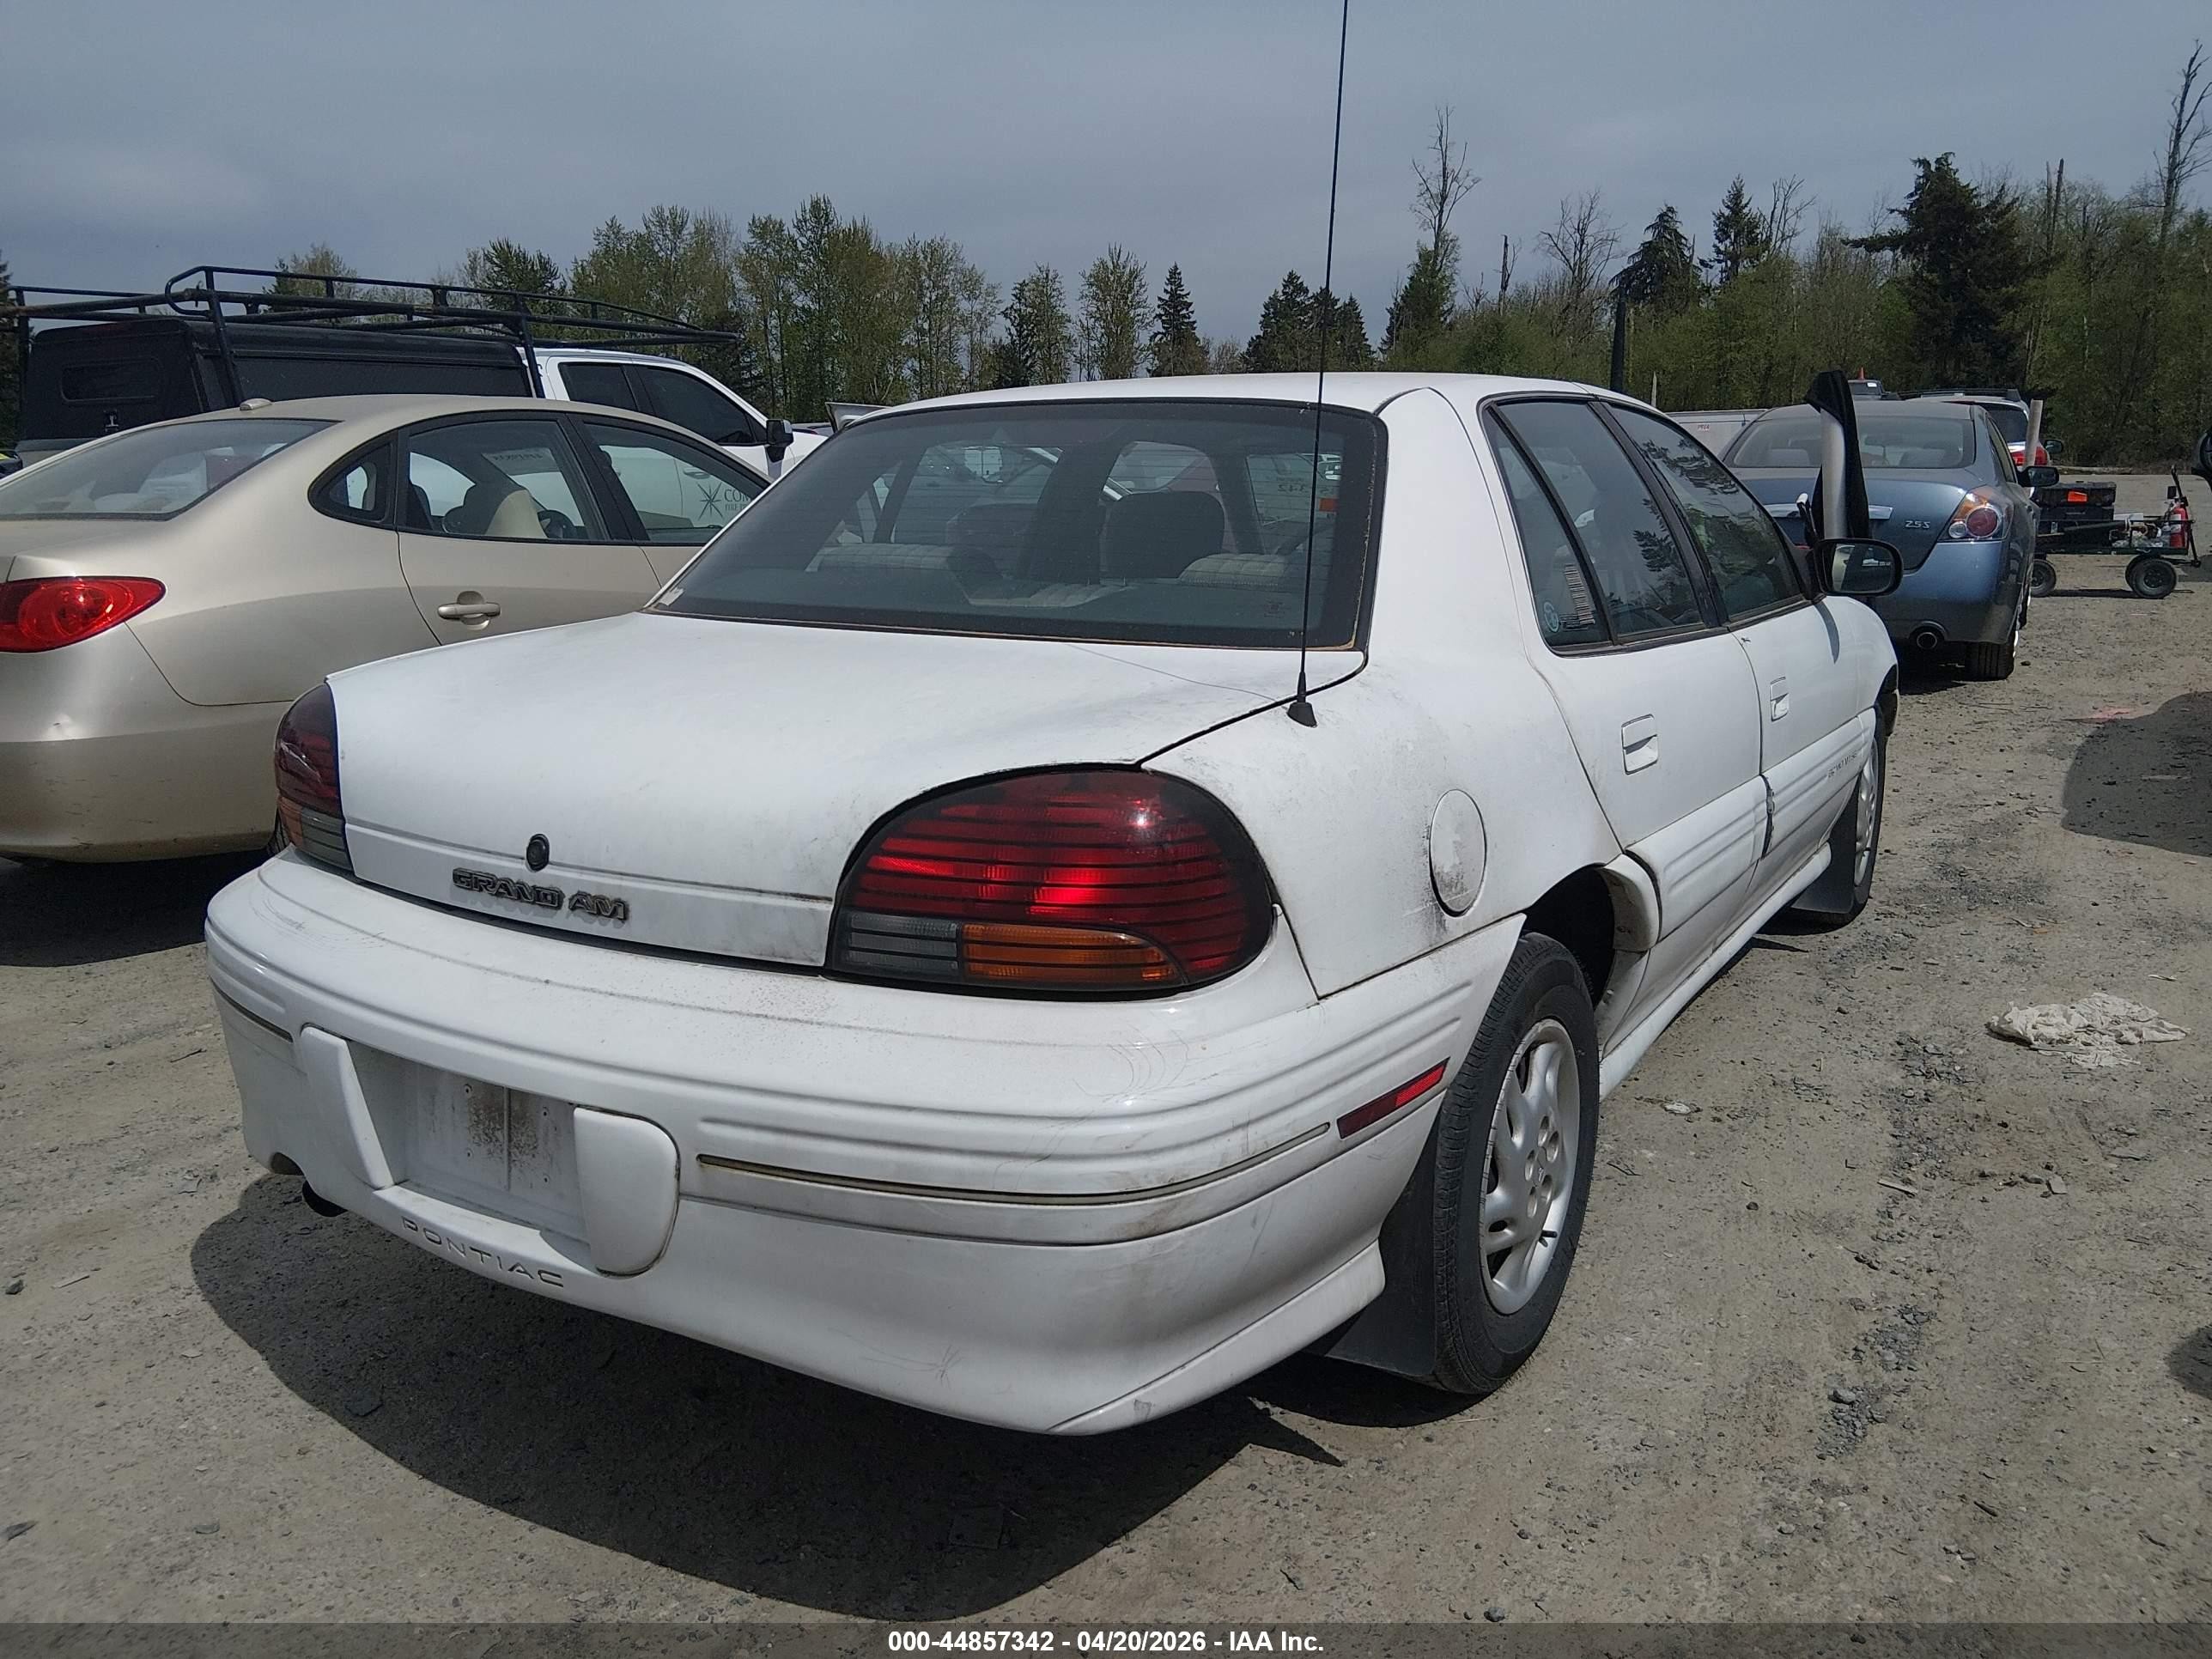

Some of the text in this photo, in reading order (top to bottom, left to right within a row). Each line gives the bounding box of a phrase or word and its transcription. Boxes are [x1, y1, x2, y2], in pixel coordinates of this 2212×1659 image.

[453, 867, 629, 921] GRAND AM
[401, 1216, 563, 1288] PONTIAC
